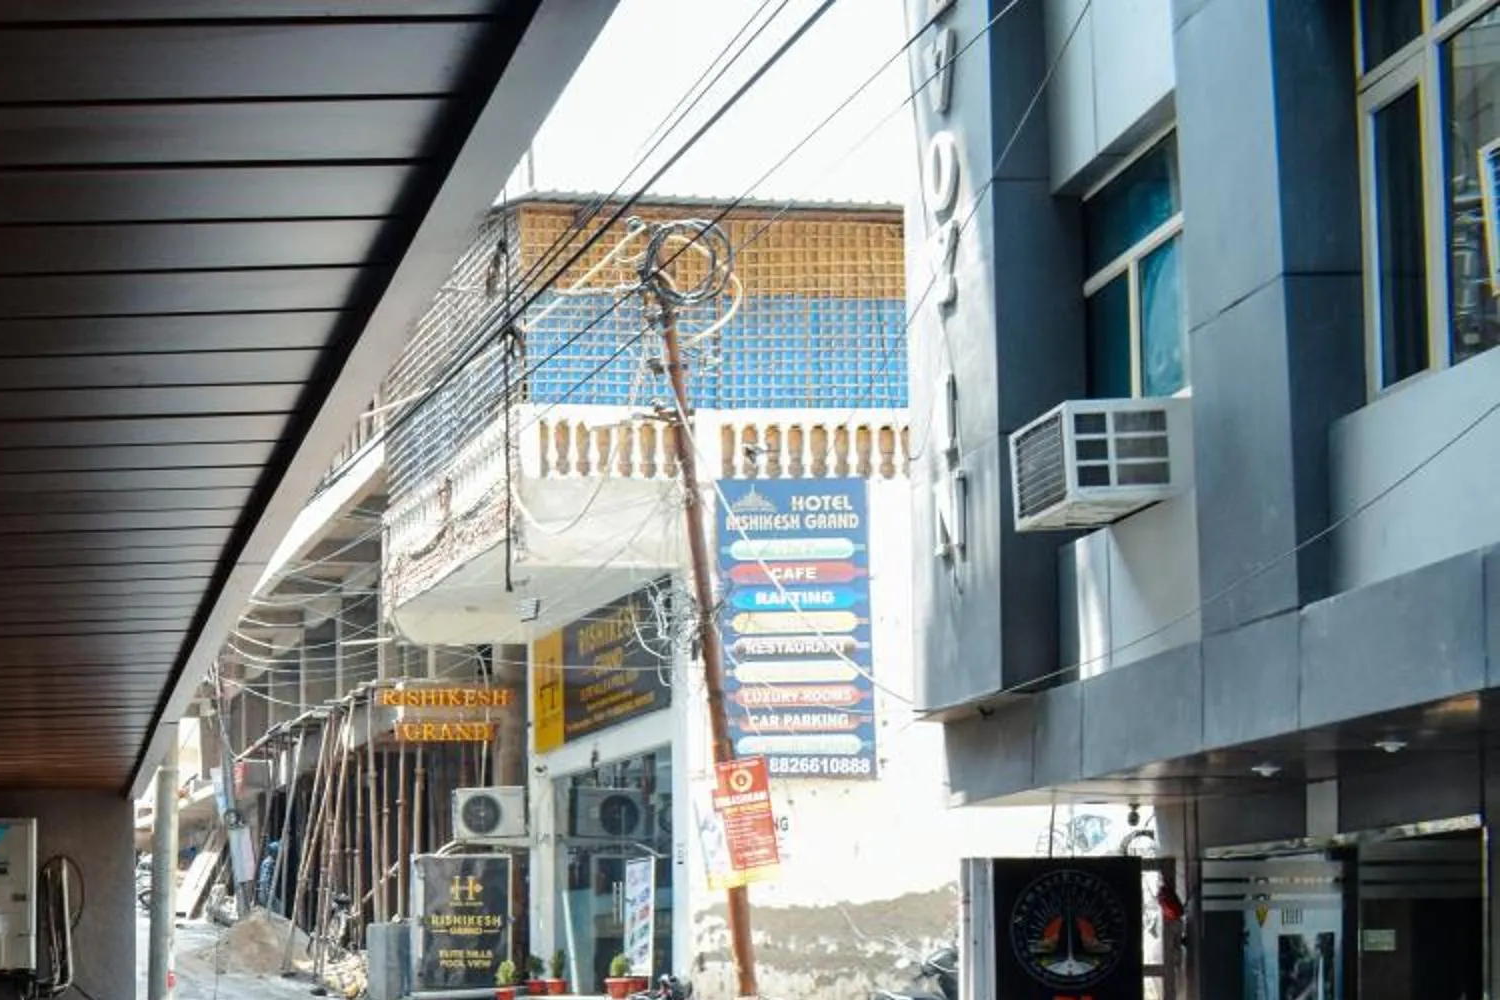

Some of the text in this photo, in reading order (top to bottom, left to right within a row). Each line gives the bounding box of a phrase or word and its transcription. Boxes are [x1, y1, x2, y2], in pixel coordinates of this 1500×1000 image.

[791, 495, 853, 511] HOTEL
[803, 512, 860, 529] GRAND
[771, 566, 817, 580] CAFE
[754, 589, 836, 606] RAFTING
[745, 640, 845, 655] RESTAURANT
[382, 688, 509, 706] RISHIKESH
[750, 712, 849, 727] CAR PARKING
[402, 722, 492, 741] GRAND
